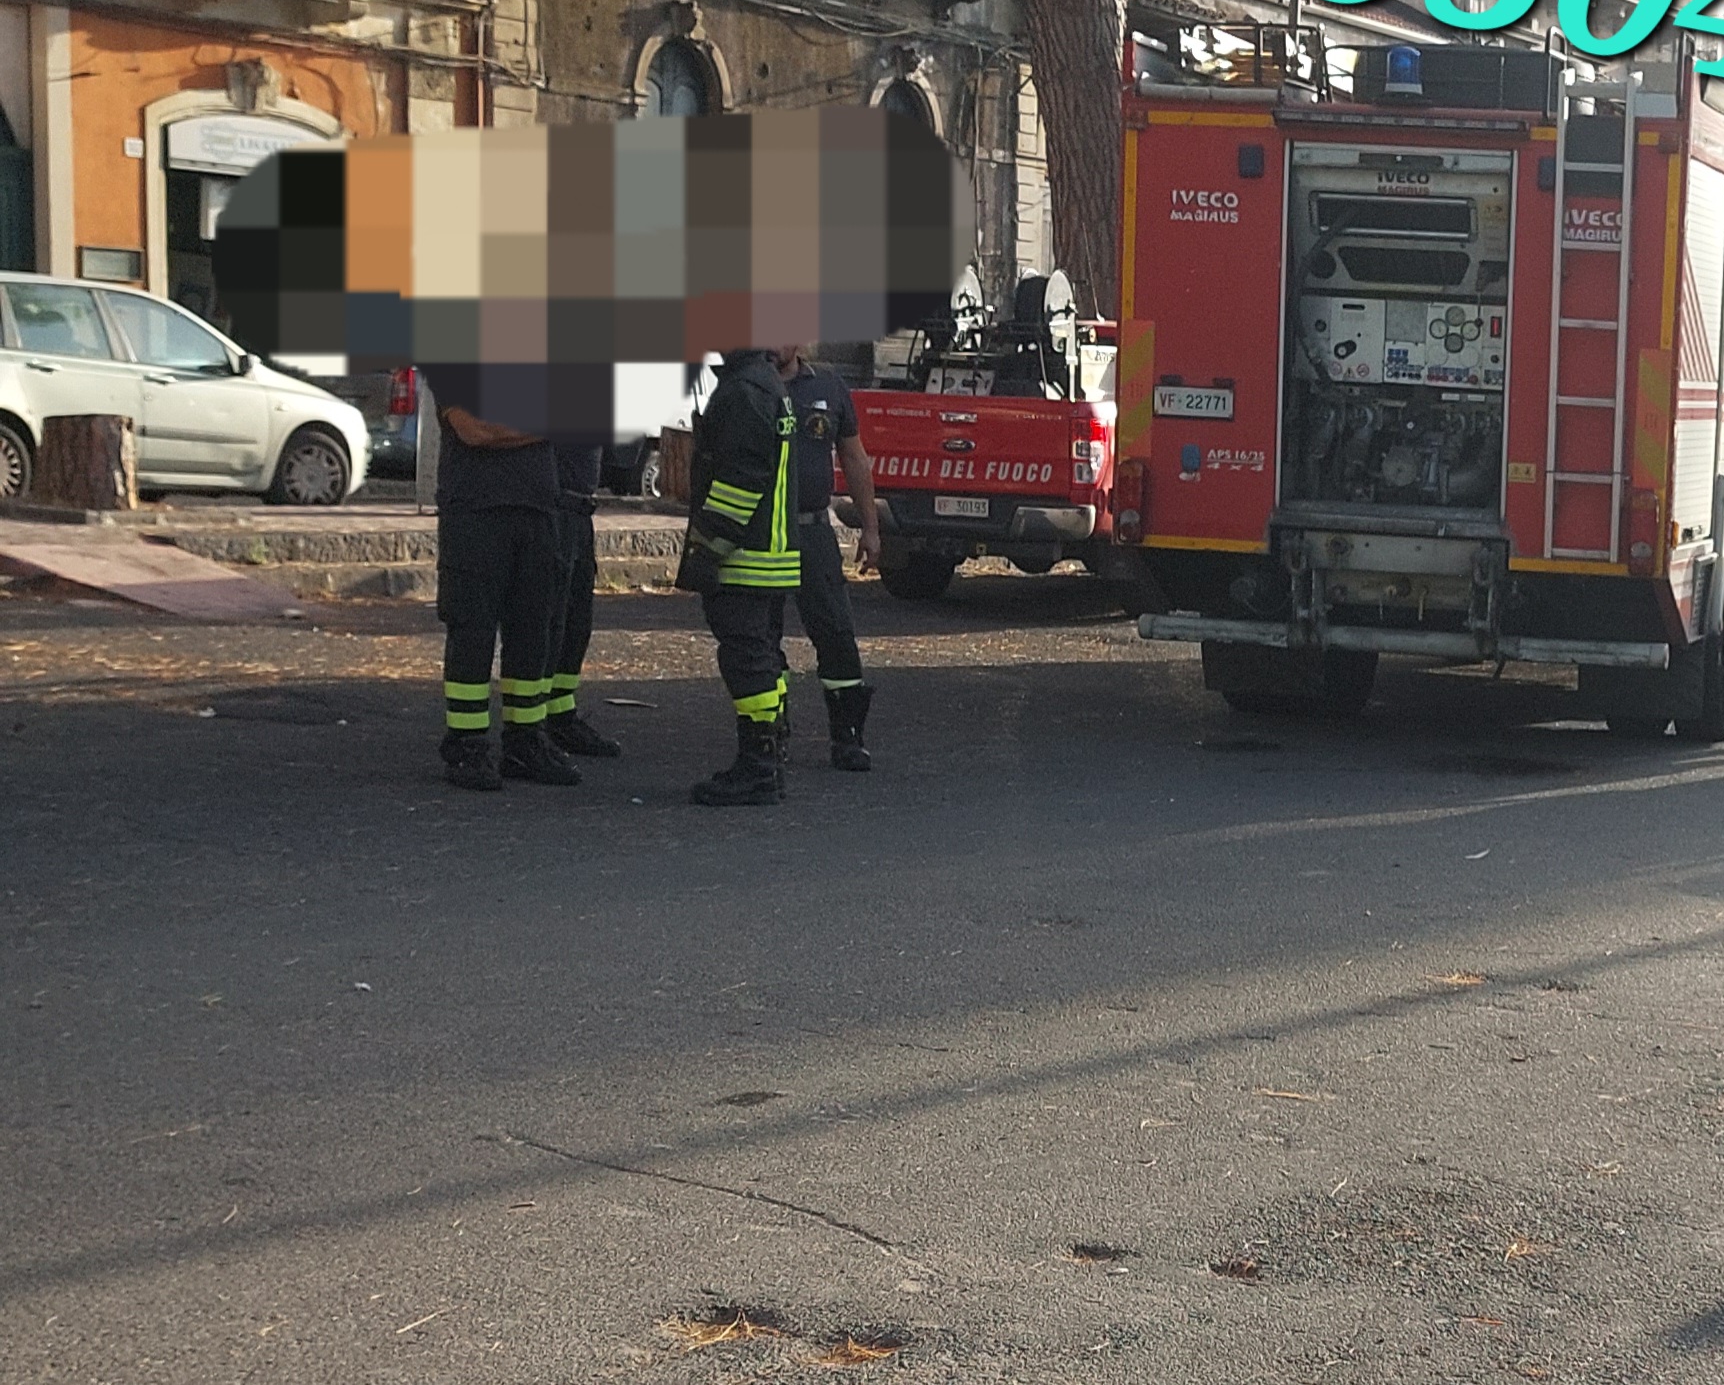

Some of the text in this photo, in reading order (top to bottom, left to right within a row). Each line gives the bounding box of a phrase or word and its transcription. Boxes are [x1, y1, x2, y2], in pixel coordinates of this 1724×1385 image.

[1378, 172, 1431, 184] IVECO
[1171, 189, 1239, 208] IVECO
[1170, 209, 1239, 224] MAGIRUS
[1160, 392, 1226, 411] VF 22771
[868, 456, 1053, 483] VIGILI DEL FUOCO
[956, 500, 987, 514] 30193
